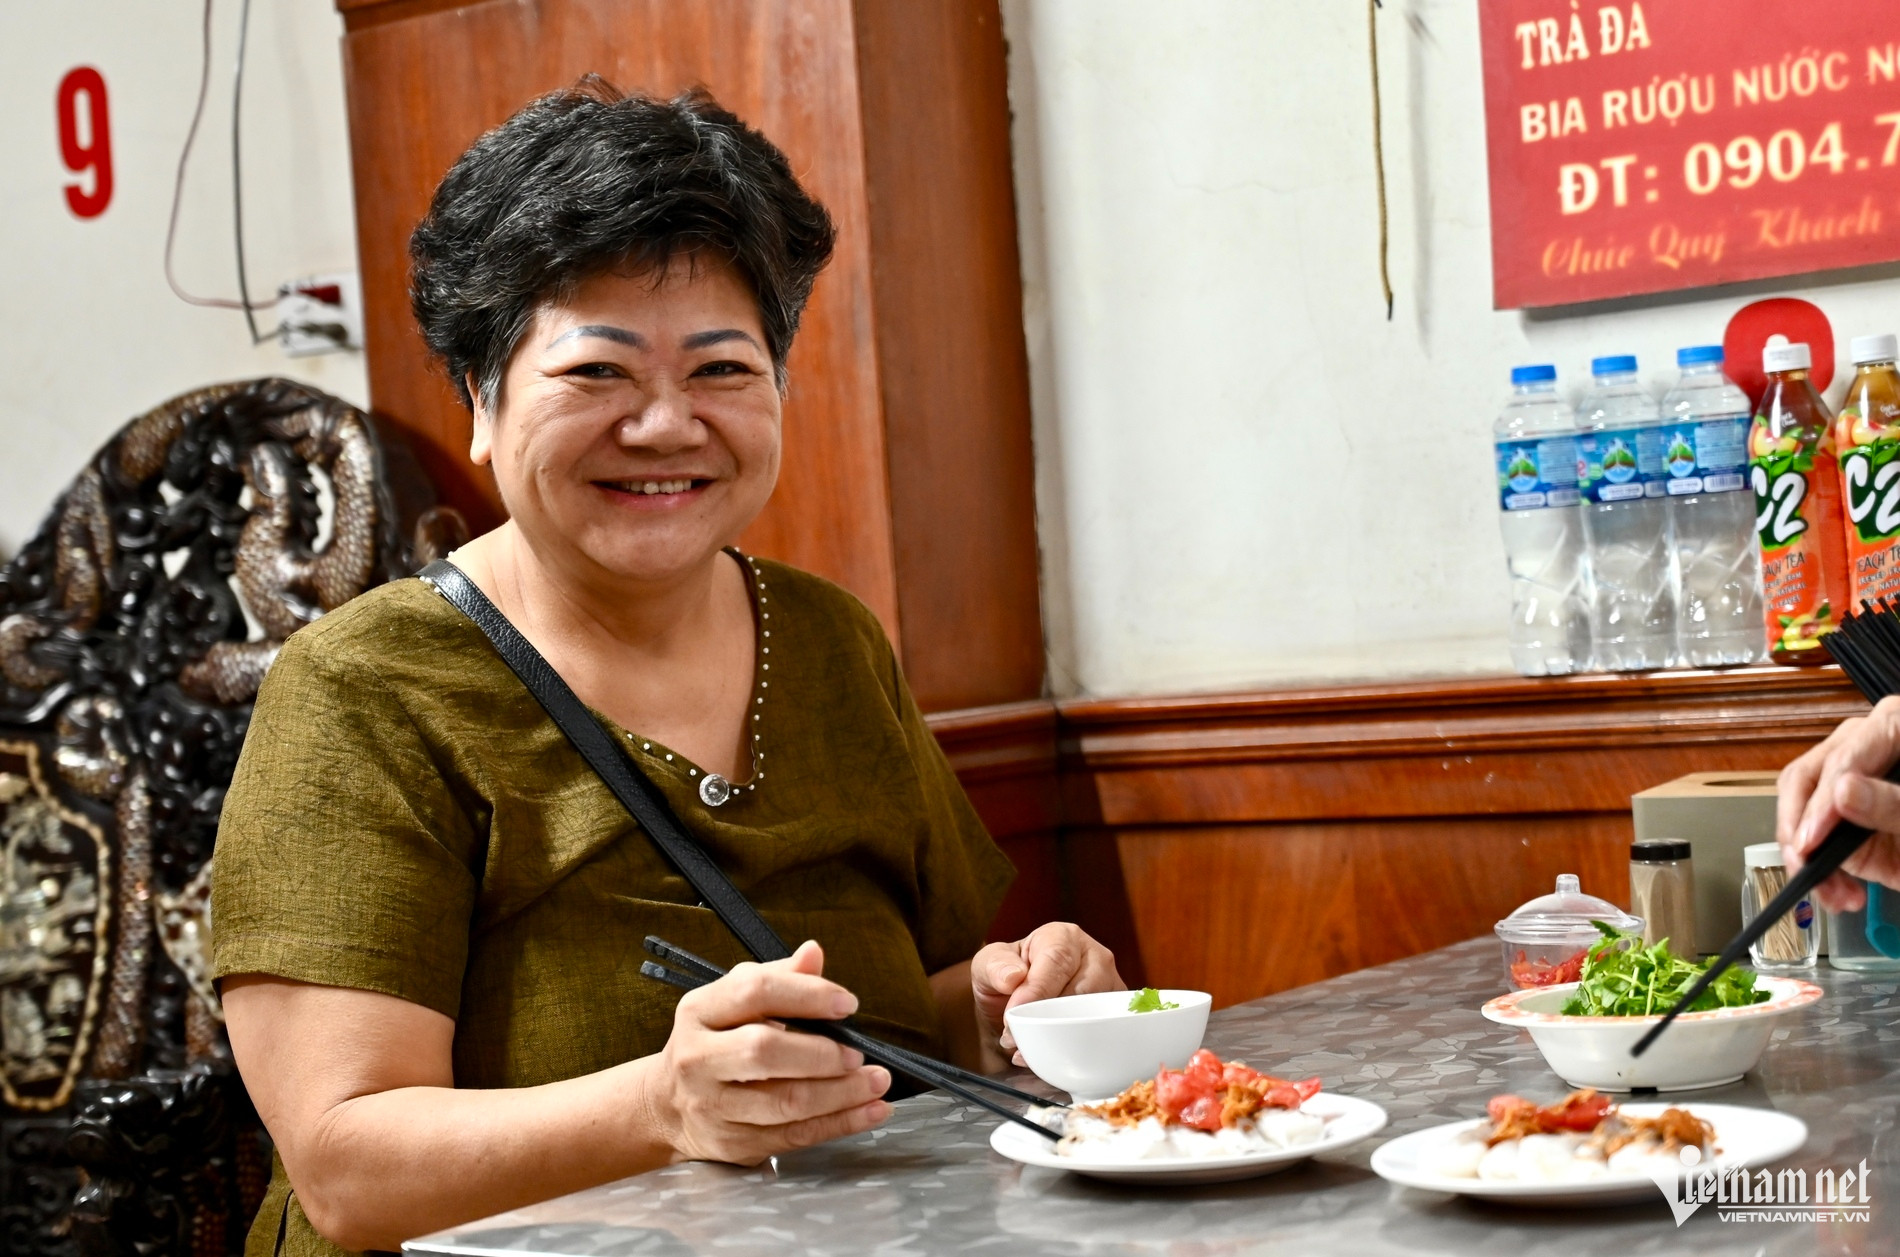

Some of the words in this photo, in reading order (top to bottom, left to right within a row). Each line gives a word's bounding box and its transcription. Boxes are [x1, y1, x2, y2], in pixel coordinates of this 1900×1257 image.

[1515, 0, 1590, 70] TRÀ
[1598, 1, 1651, 56] ĐA
[1520, 97, 1588, 143] BIA
[1602, 73, 1716, 129] RƯỢU
[1733, 46, 1850, 108] NƯỚC
[1865, 42, 1900, 85] N
[56, 65, 114, 221] 9
[1558, 154, 1659, 215] ĐT:
[1751, 465, 1806, 543] C2
[1845, 454, 1900, 534] C2
[1786, 551, 1805, 570] TEA
